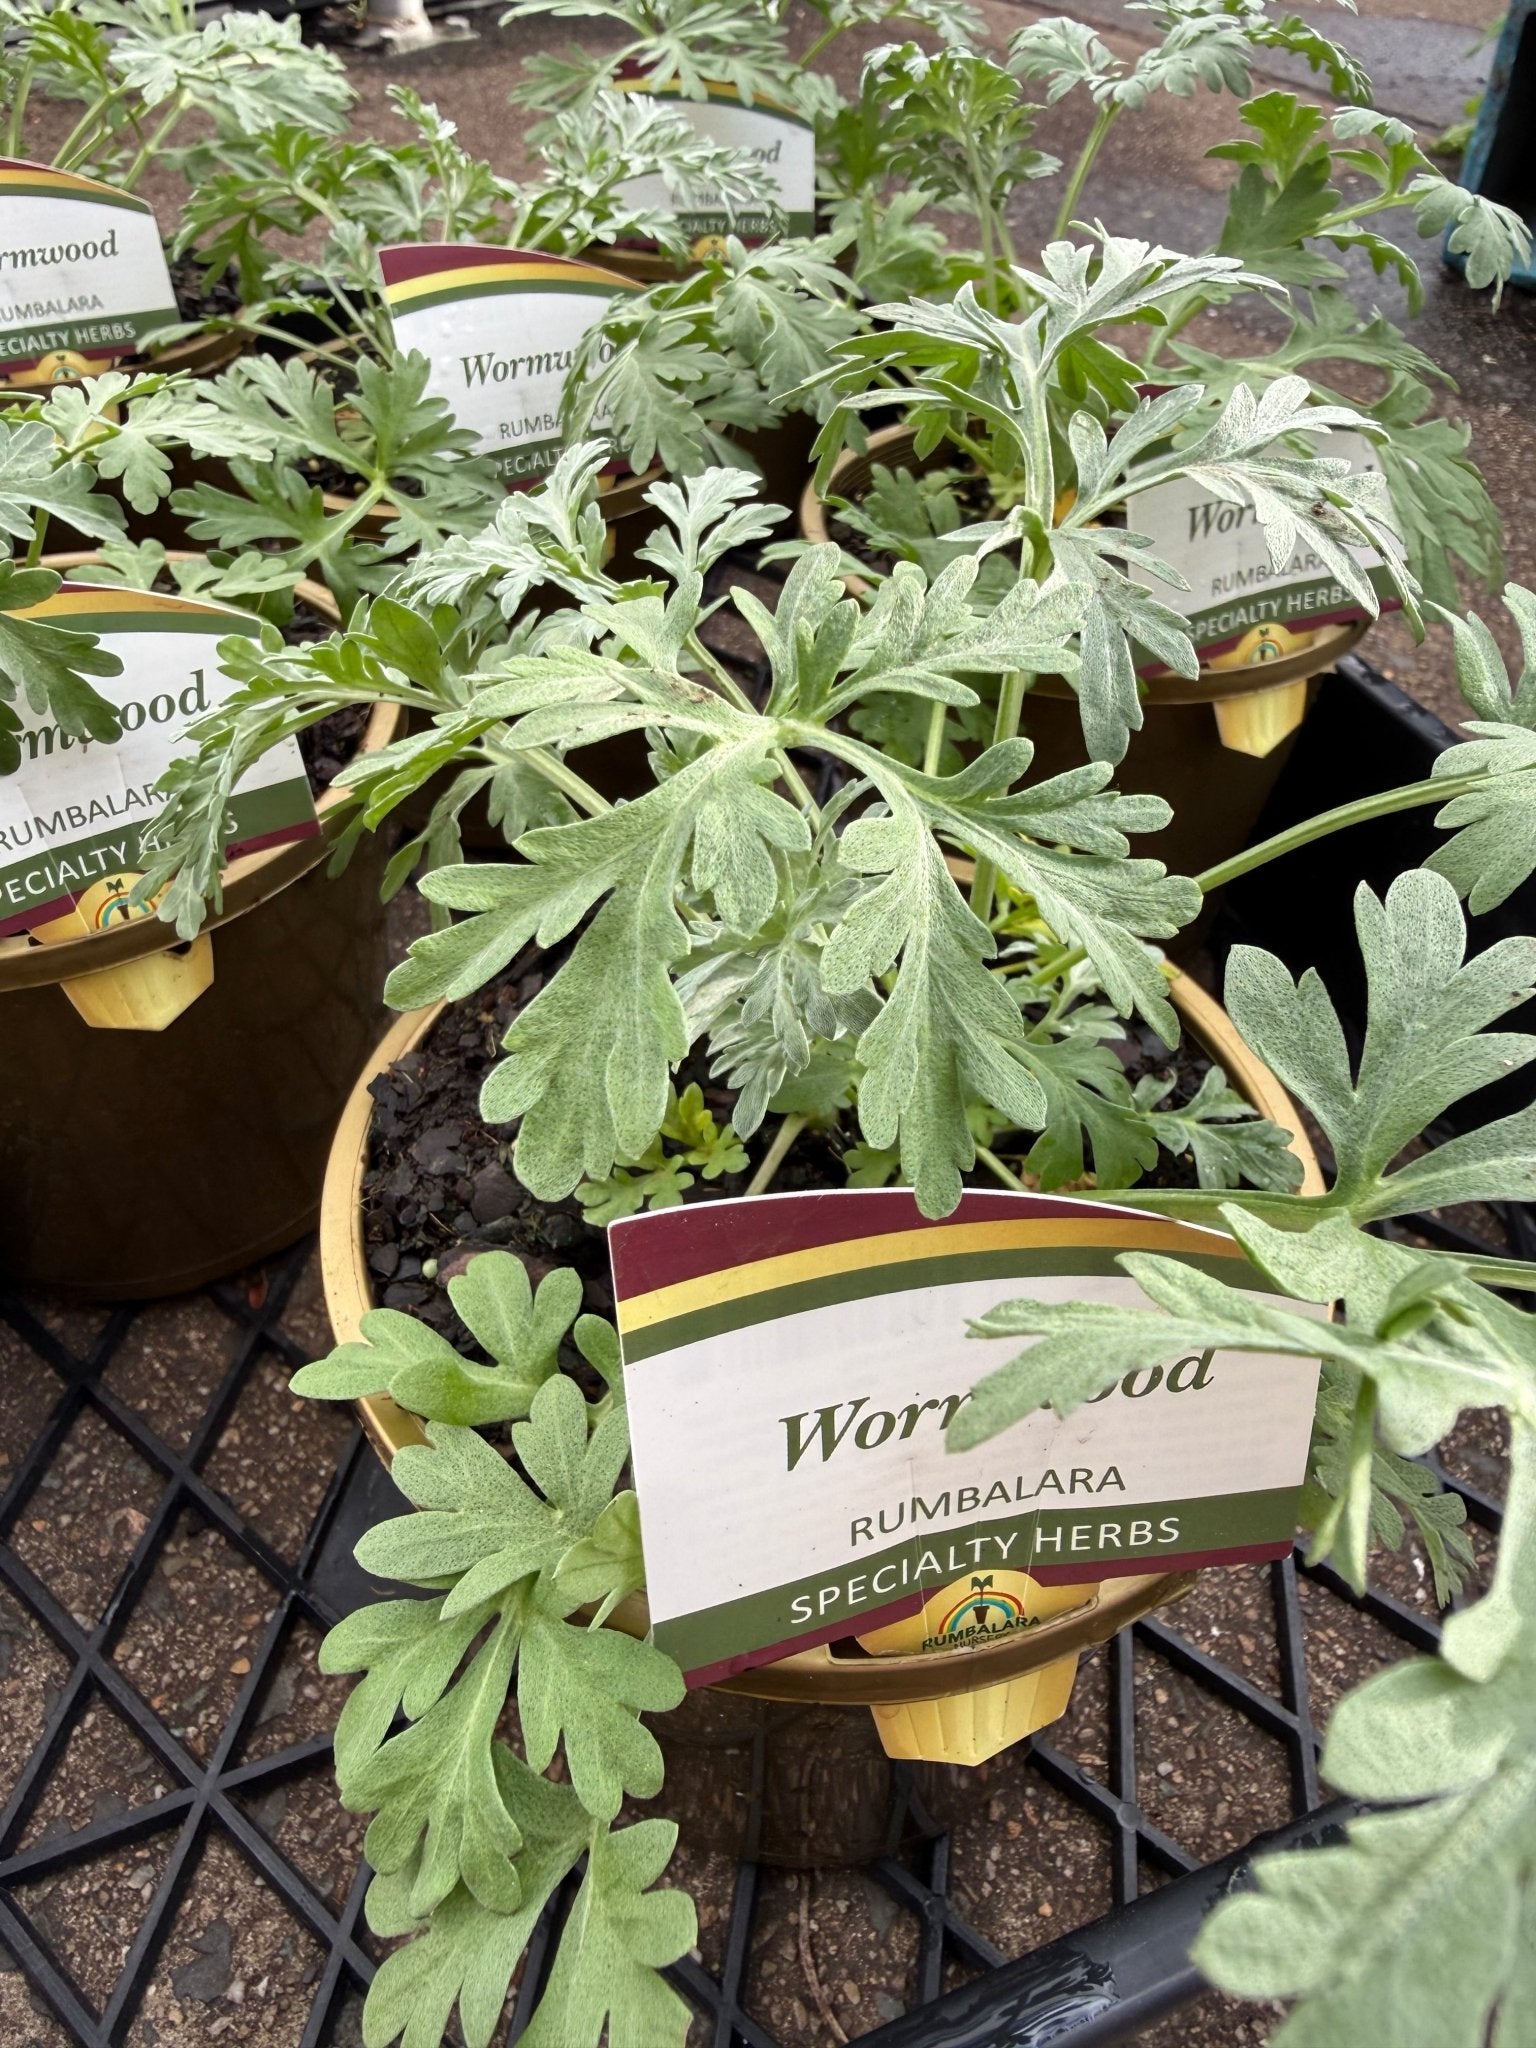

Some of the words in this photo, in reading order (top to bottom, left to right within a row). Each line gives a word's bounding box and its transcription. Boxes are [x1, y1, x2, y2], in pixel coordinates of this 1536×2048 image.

[74, 321, 137, 345] HERBS
[0, 841, 126, 904] ECIALTY
[778, 1347, 1215, 1472] Worod
[850, 1465, 1126, 1547] RUMBALARA
[790, 1532, 1019, 1625] SPECIALTY
[1034, 1517, 1181, 1554] HERBS
[922, 1615, 1041, 1651] RUMBALARA
